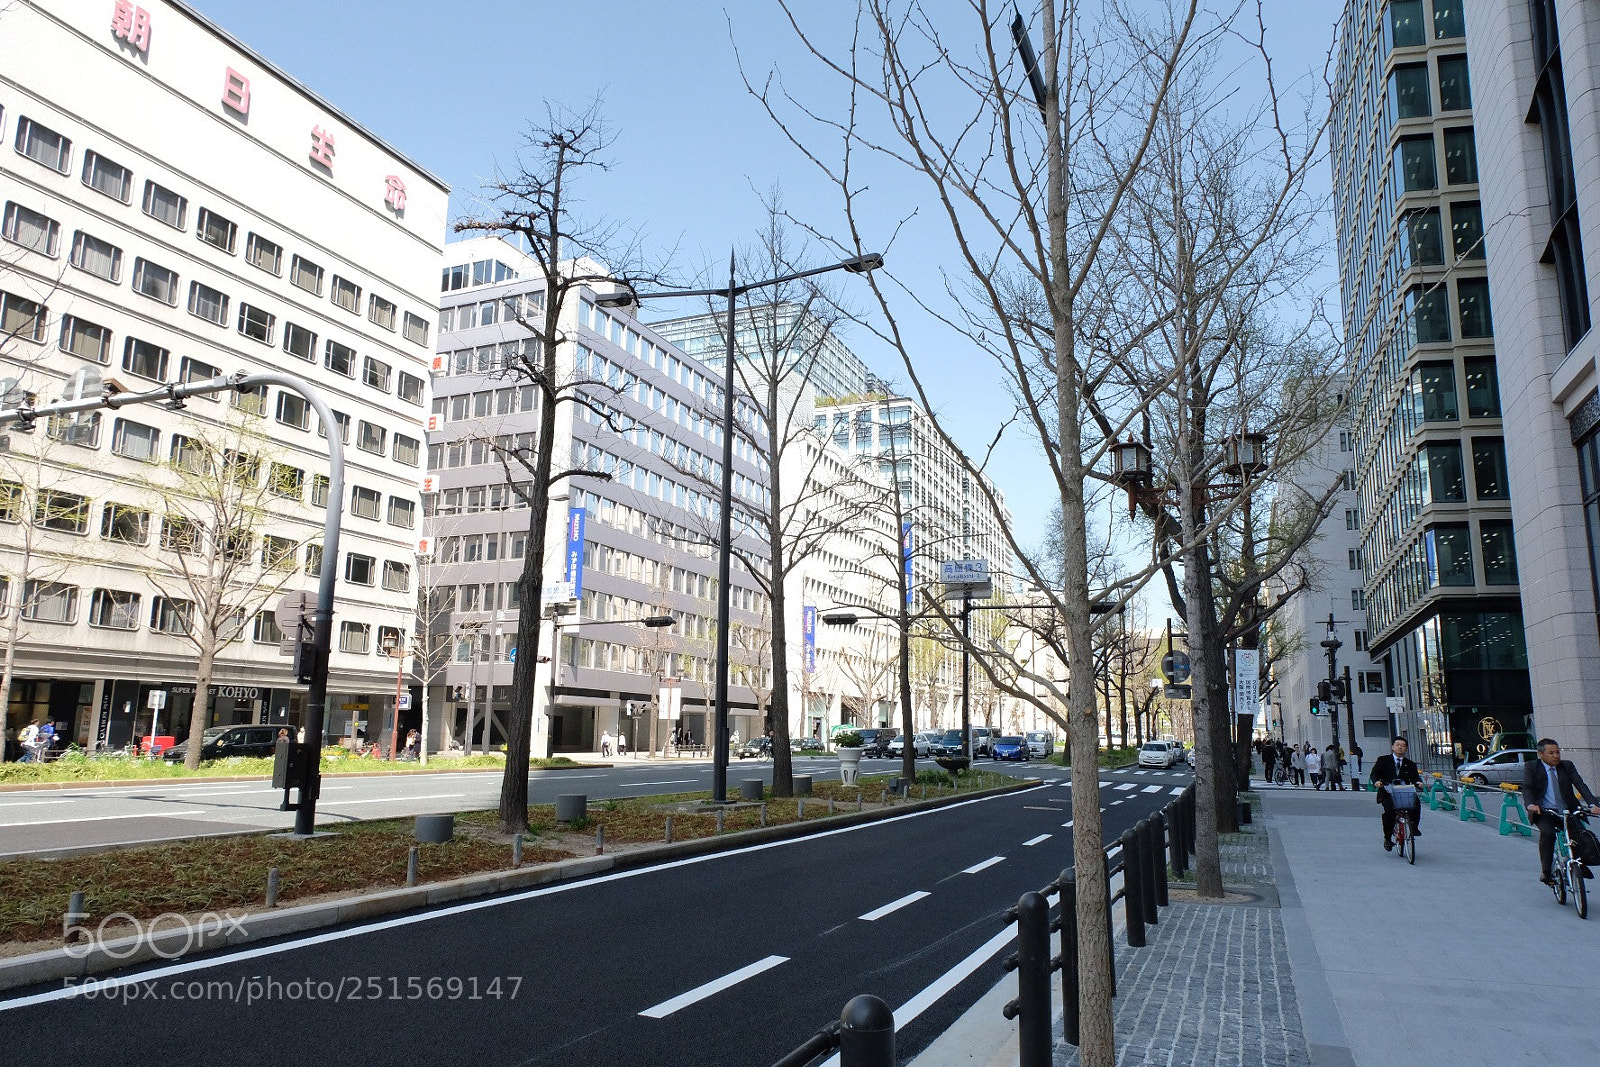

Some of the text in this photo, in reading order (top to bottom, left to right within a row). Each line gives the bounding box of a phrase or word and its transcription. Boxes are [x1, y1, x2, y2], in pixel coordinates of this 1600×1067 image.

[111, 0, 406, 211] 朝日生命
[217, 686, 259, 699] KOHYO
